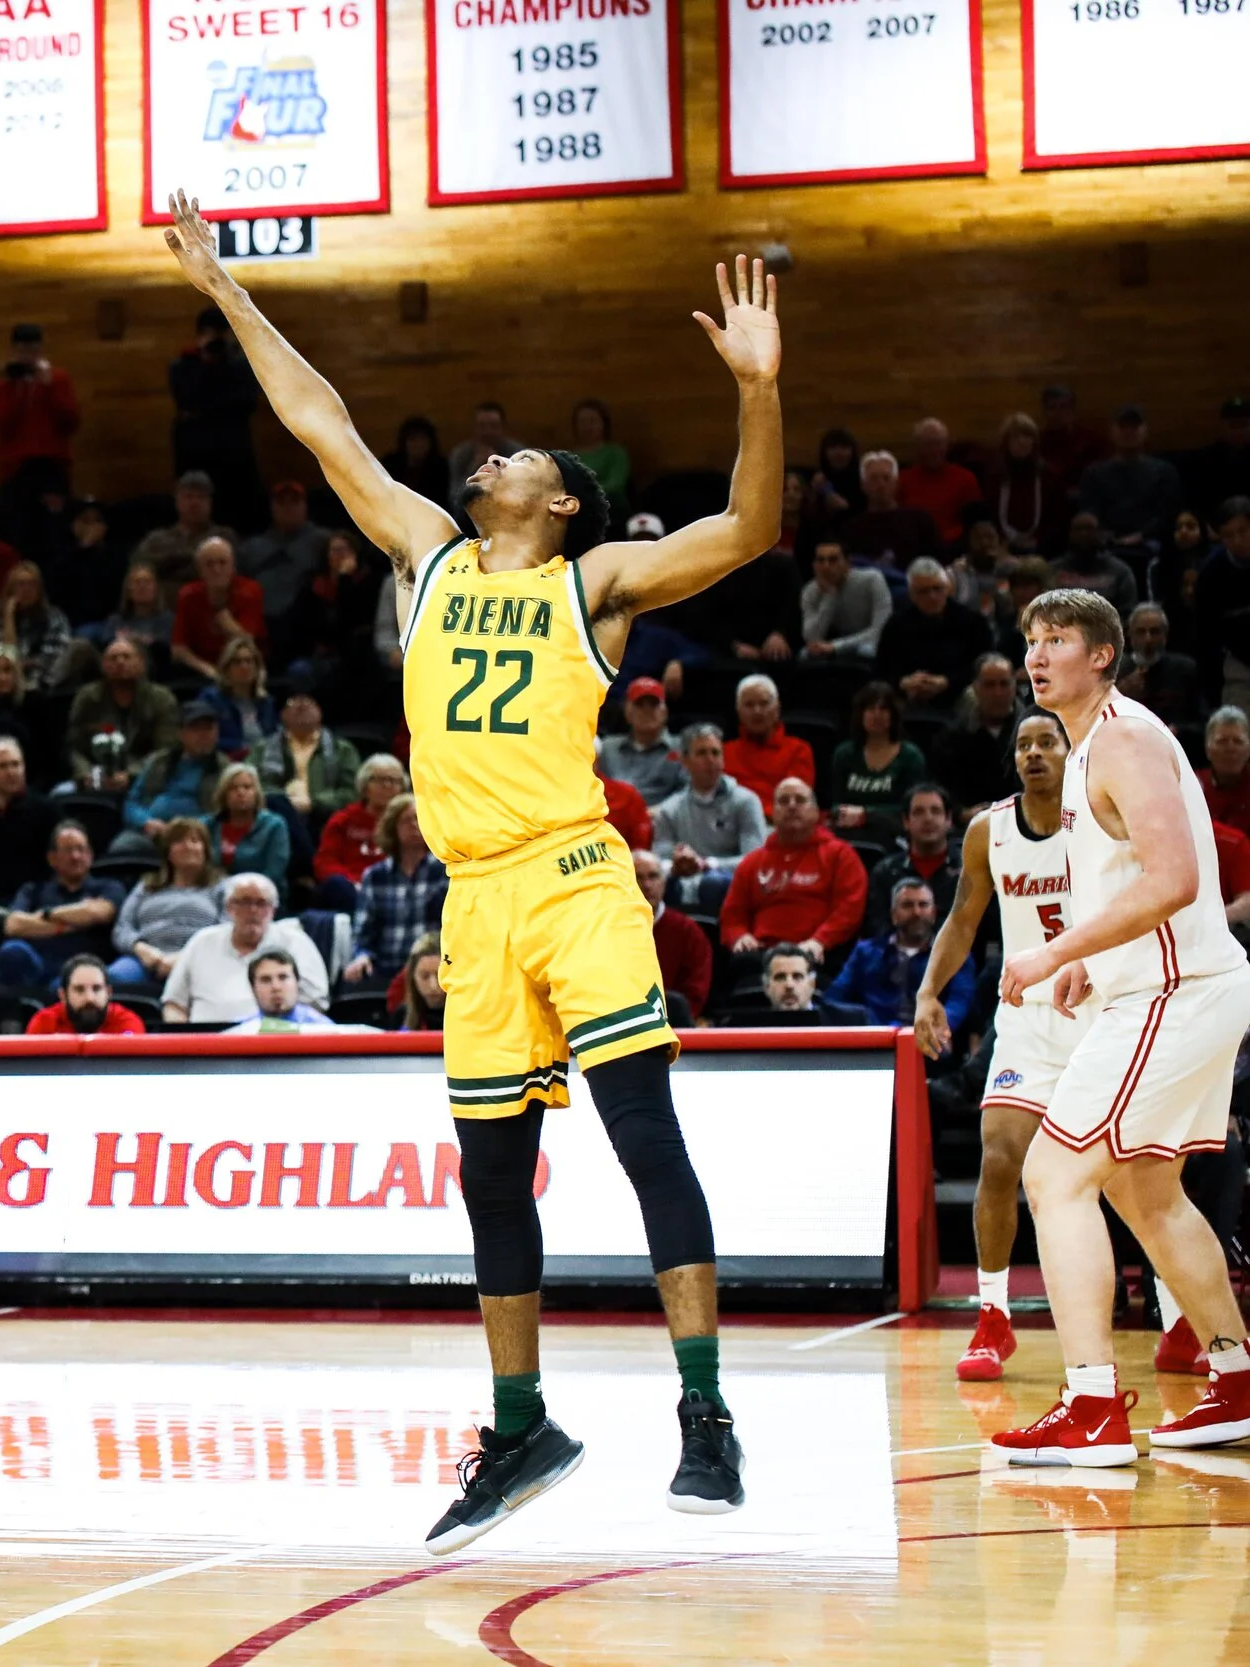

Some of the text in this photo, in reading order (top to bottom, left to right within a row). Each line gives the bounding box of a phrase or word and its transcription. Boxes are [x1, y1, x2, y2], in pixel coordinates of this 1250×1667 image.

[168, 3, 360, 42] SWEET 16
[455, 0, 651, 29] CHAMPIONS
[1071, 0, 1140, 22] 1986
[761, 14, 936, 46] 2002 2007
[0, 33, 81, 62] ROUND
[512, 41, 599, 73] 1985
[513, 87, 599, 118] 1987
[515, 132, 602, 163] 1988
[225, 163, 308, 193] 2007
[228, 217, 305, 256] 103
[441, 593, 554, 640] SIENA
[446, 647, 534, 736] 22
[1001, 873, 1068, 897] MARI
[1036, 903, 1065, 943] 5
[87, 1132, 552, 1209] HIGHLAN
[410, 1272, 477, 1285] DAKTRO
